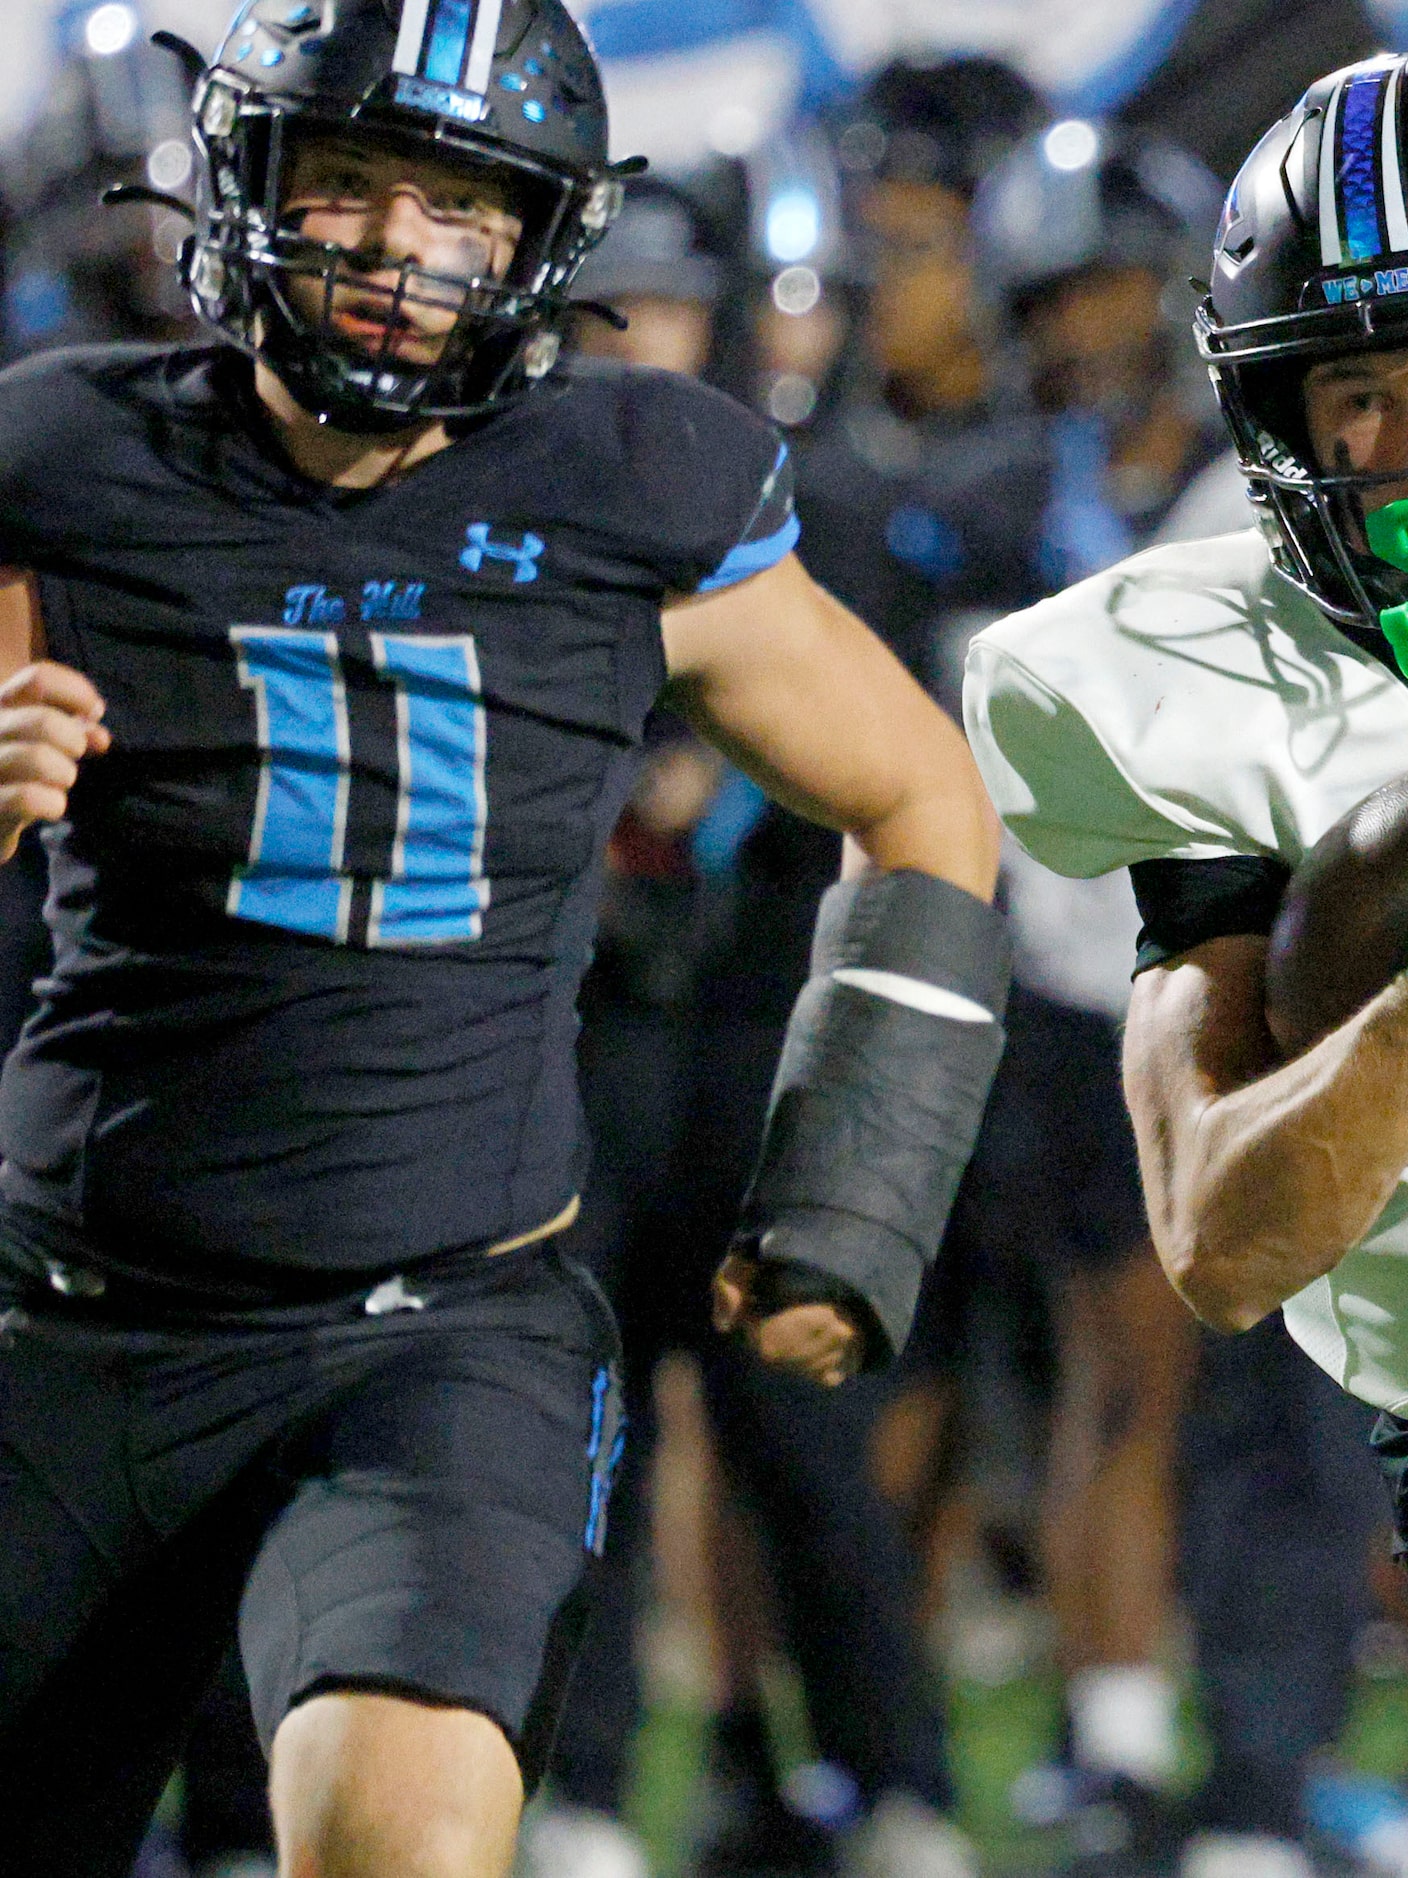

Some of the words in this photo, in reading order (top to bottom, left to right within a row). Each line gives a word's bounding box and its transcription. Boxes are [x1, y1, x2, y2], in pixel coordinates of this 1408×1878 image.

[1322, 276, 1360, 304] WE
[283, 584, 346, 625] The
[360, 580, 427, 621] Hill
[226, 625, 490, 949] 11
